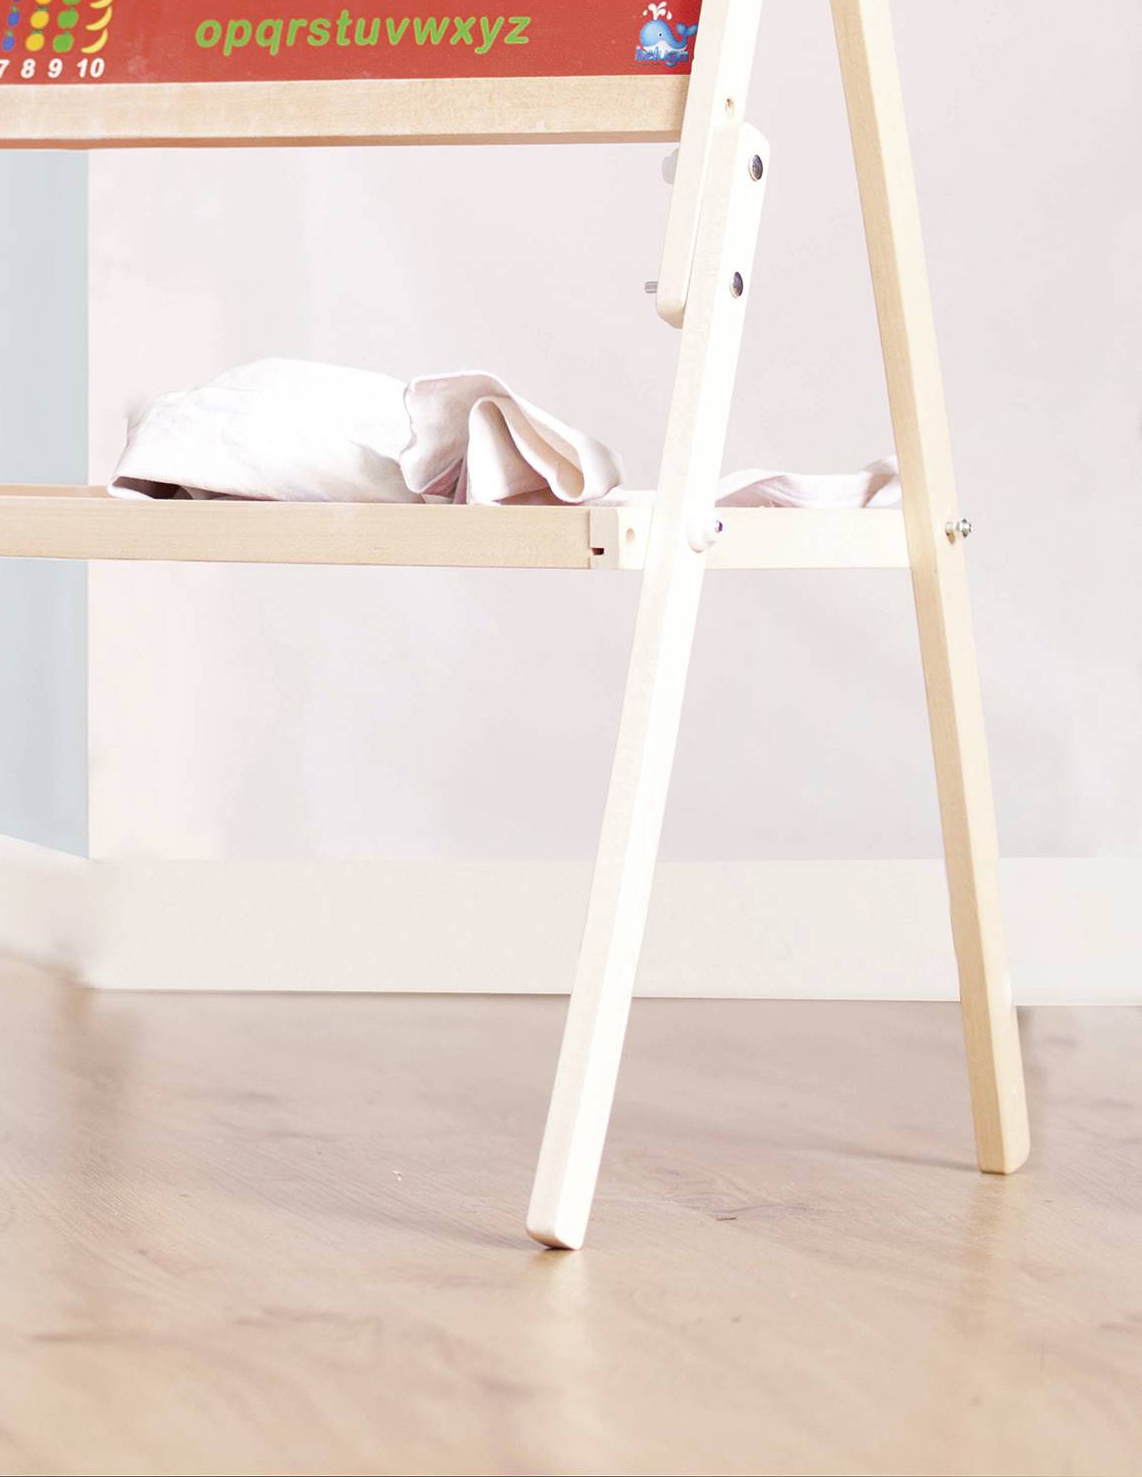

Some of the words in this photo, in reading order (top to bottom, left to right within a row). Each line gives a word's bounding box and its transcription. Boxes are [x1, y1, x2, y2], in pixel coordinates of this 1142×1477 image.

[194, 10, 532, 56] opqrstuvwxyz
[20, 58, 36, 79] 8
[47, 57, 63, 79] 9
[76, 57, 106, 78] 10
